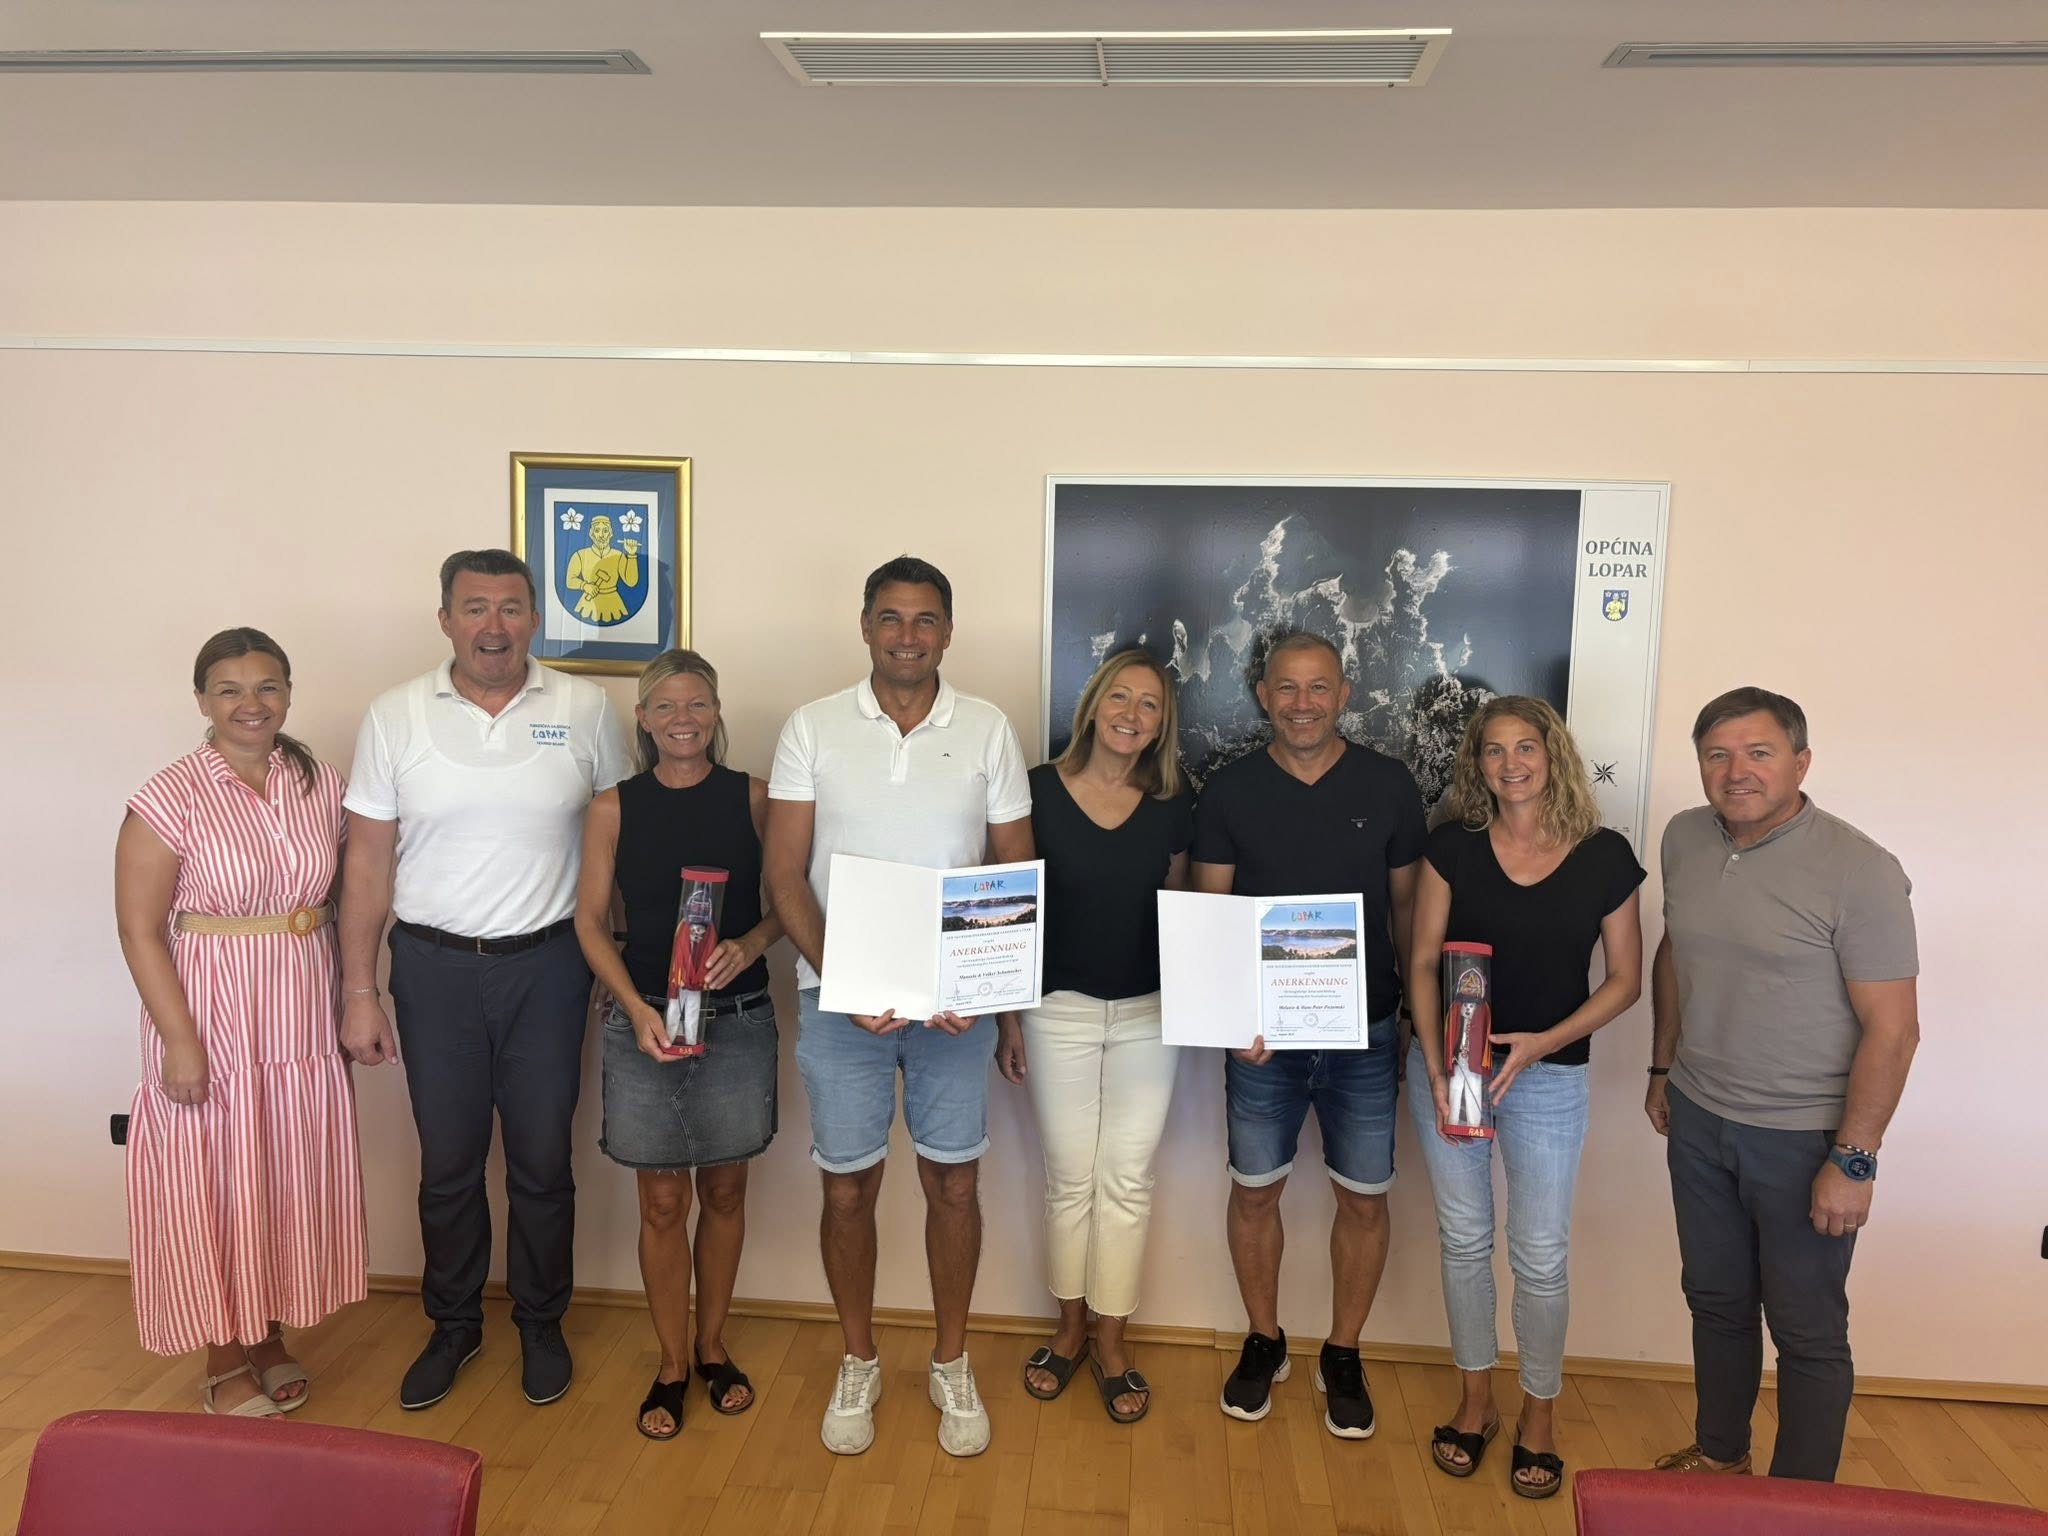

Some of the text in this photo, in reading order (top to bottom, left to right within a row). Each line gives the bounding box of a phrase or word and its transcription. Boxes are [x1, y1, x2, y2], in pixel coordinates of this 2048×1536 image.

[1585, 537, 1653, 556] OPĆINA
[1588, 563, 1647, 578] LOPAR
[532, 729, 568, 740] LOPAR
[973, 880, 1006, 893] LOPAR
[1291, 911, 1325, 923] LOPAR
[949, 941, 1027, 958] ANERKENNUNG
[1270, 977, 1349, 987] ANERKENNUNG
[1468, 1128, 1484, 1137] RAB
